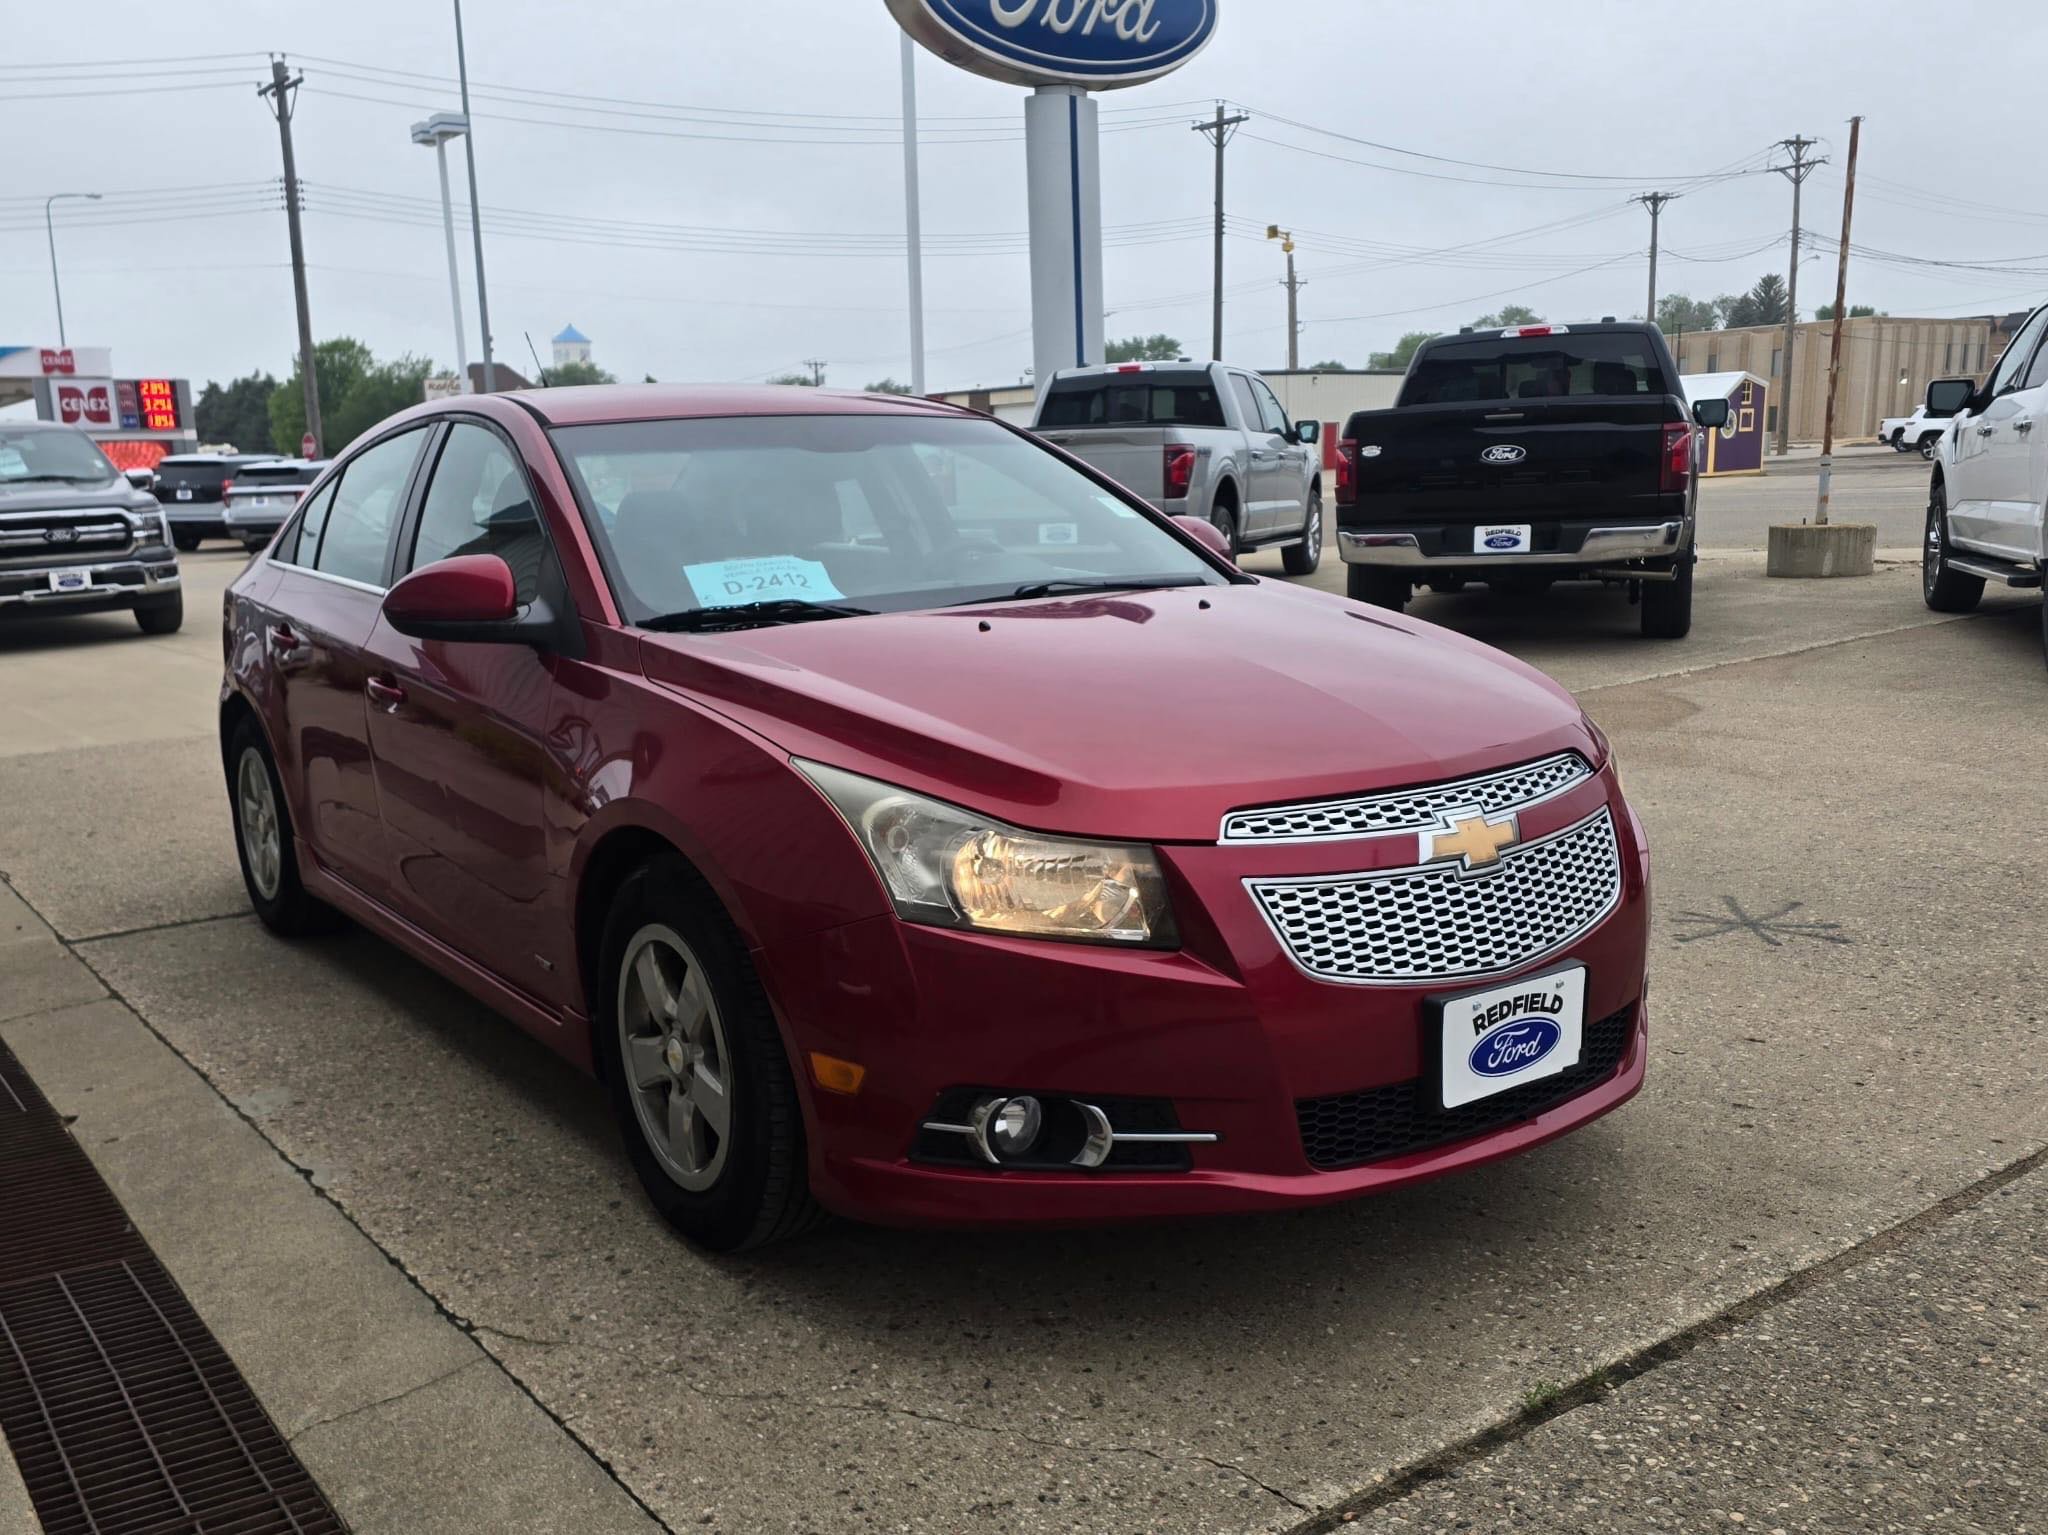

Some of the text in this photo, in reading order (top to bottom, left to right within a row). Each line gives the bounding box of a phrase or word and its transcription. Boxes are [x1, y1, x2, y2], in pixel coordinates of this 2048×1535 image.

[42, 355, 73, 366] CENEX
[62, 397, 110, 412] CENEX
[1488, 447, 1519, 460] Ford
[1490, 536, 1515, 547] Ford
[723, 572, 812, 595] D-2412
[1472, 992, 1564, 1036] REDFIELD
[1487, 1027, 1543, 1068] Ford
